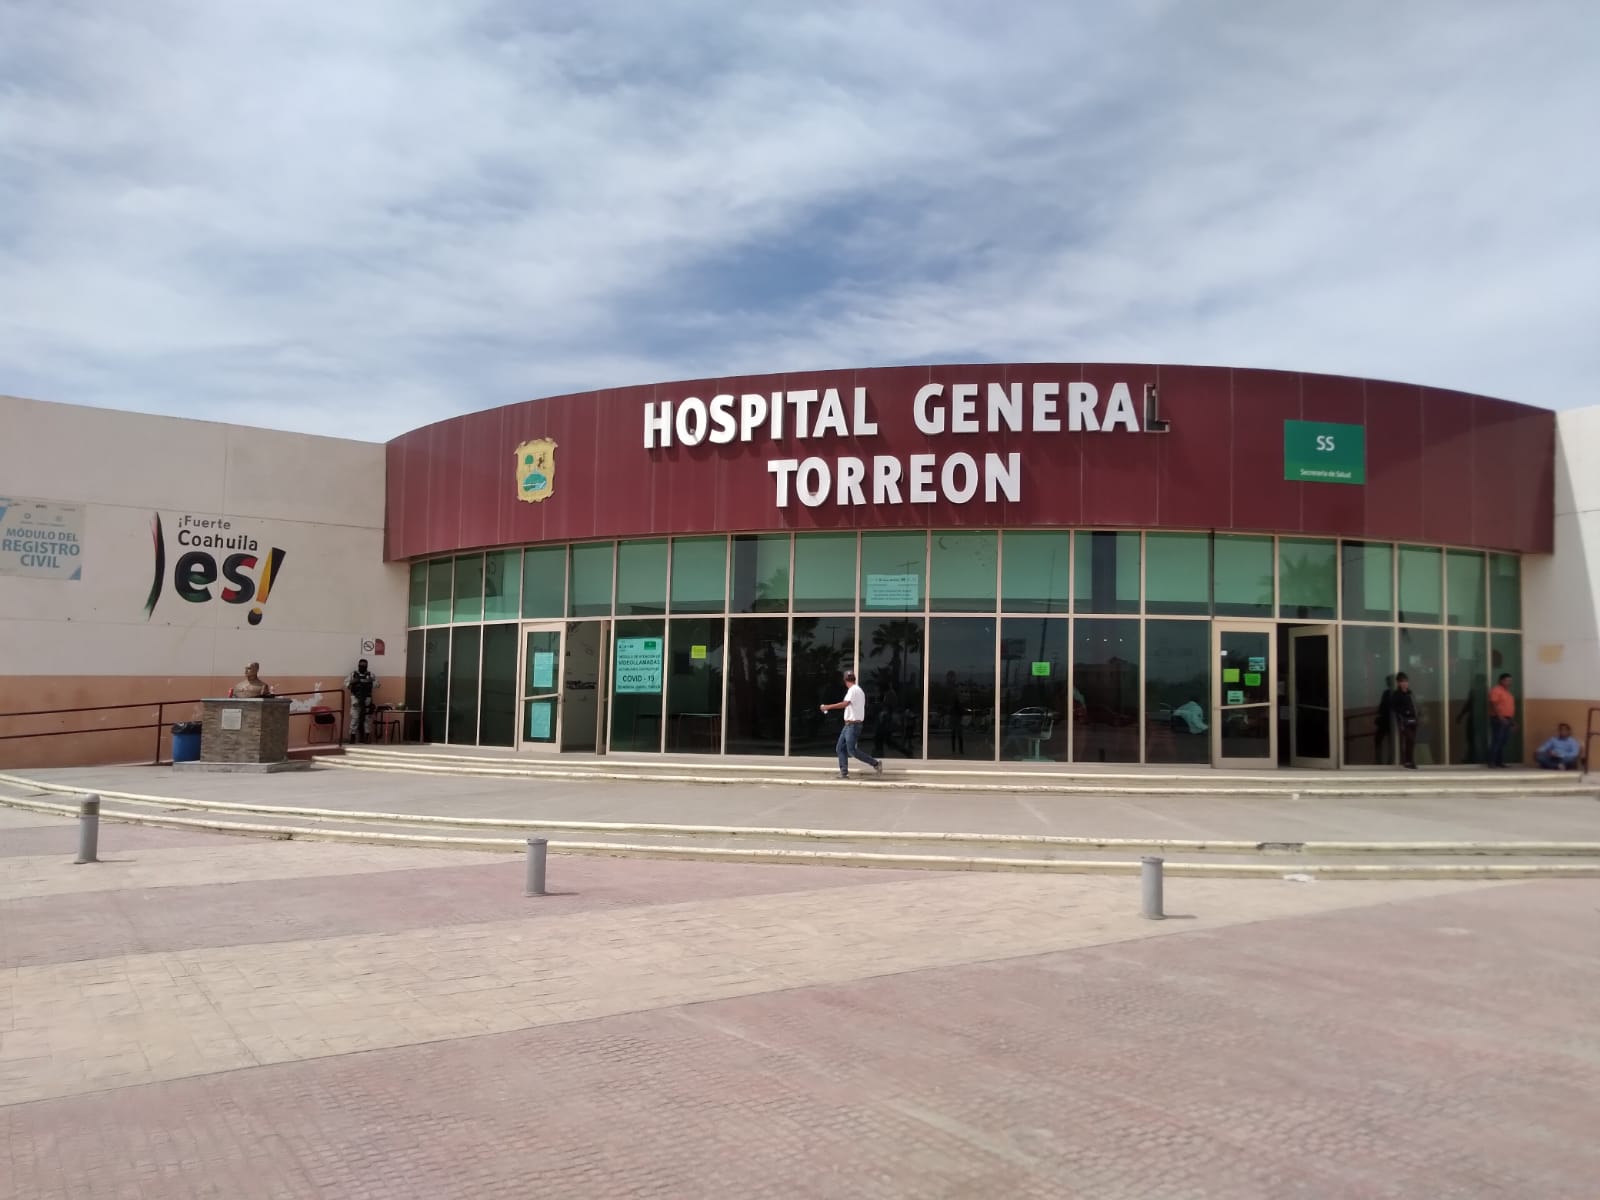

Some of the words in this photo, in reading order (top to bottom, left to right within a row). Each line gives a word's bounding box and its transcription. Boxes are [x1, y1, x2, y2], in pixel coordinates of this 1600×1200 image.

[643, 387, 879, 449] HOSPITAL
[913, 382, 1171, 435] GENERAL
[1315, 435, 1336, 451] SS
[767, 452, 1022, 508] TORREON
[178, 515, 232, 530] ¡Fuerte
[6, 527, 56, 541] MÓDULO
[58, 531, 79, 543] DEL
[177, 529, 259, 551] Coahuila
[1, 538, 81, 556] REGISTRO
[20, 554, 61, 569] CIVIL
